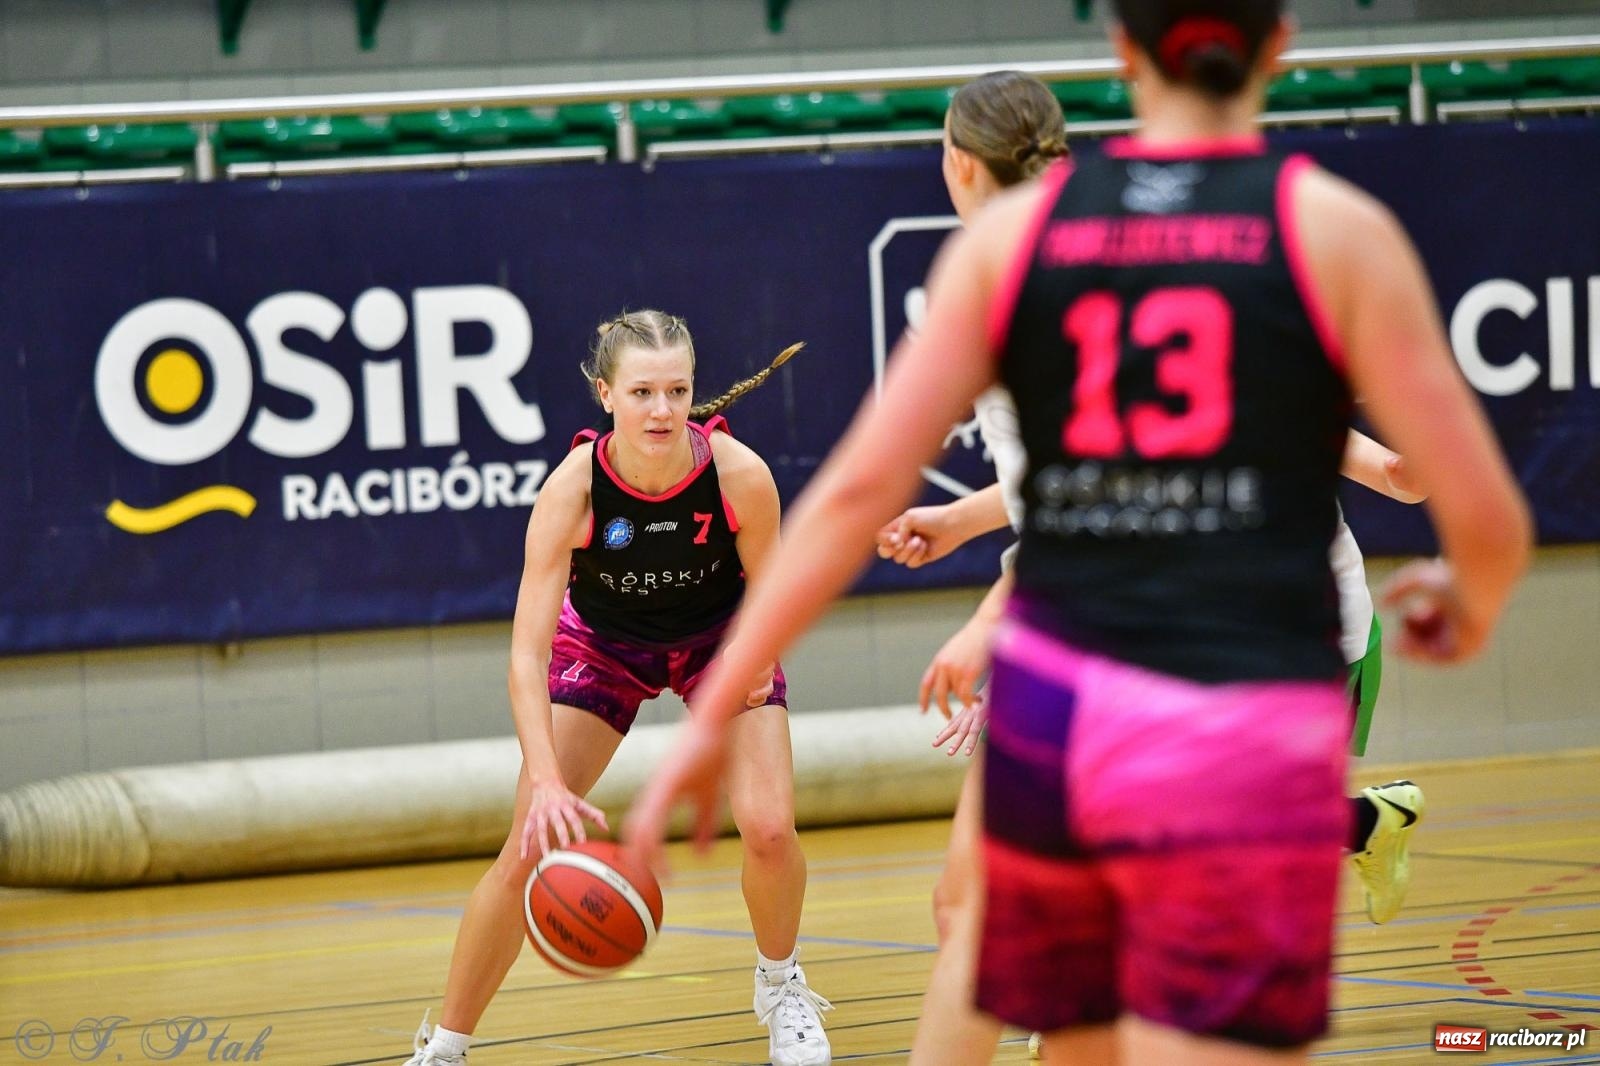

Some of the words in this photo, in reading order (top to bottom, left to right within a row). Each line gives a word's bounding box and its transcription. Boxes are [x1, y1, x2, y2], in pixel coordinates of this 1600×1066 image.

[95, 284, 545, 466] OSiR
[1062, 286, 1235, 459] 13
[281, 451, 548, 520] RACIBÓRZ
[693, 511, 713, 545] 7
